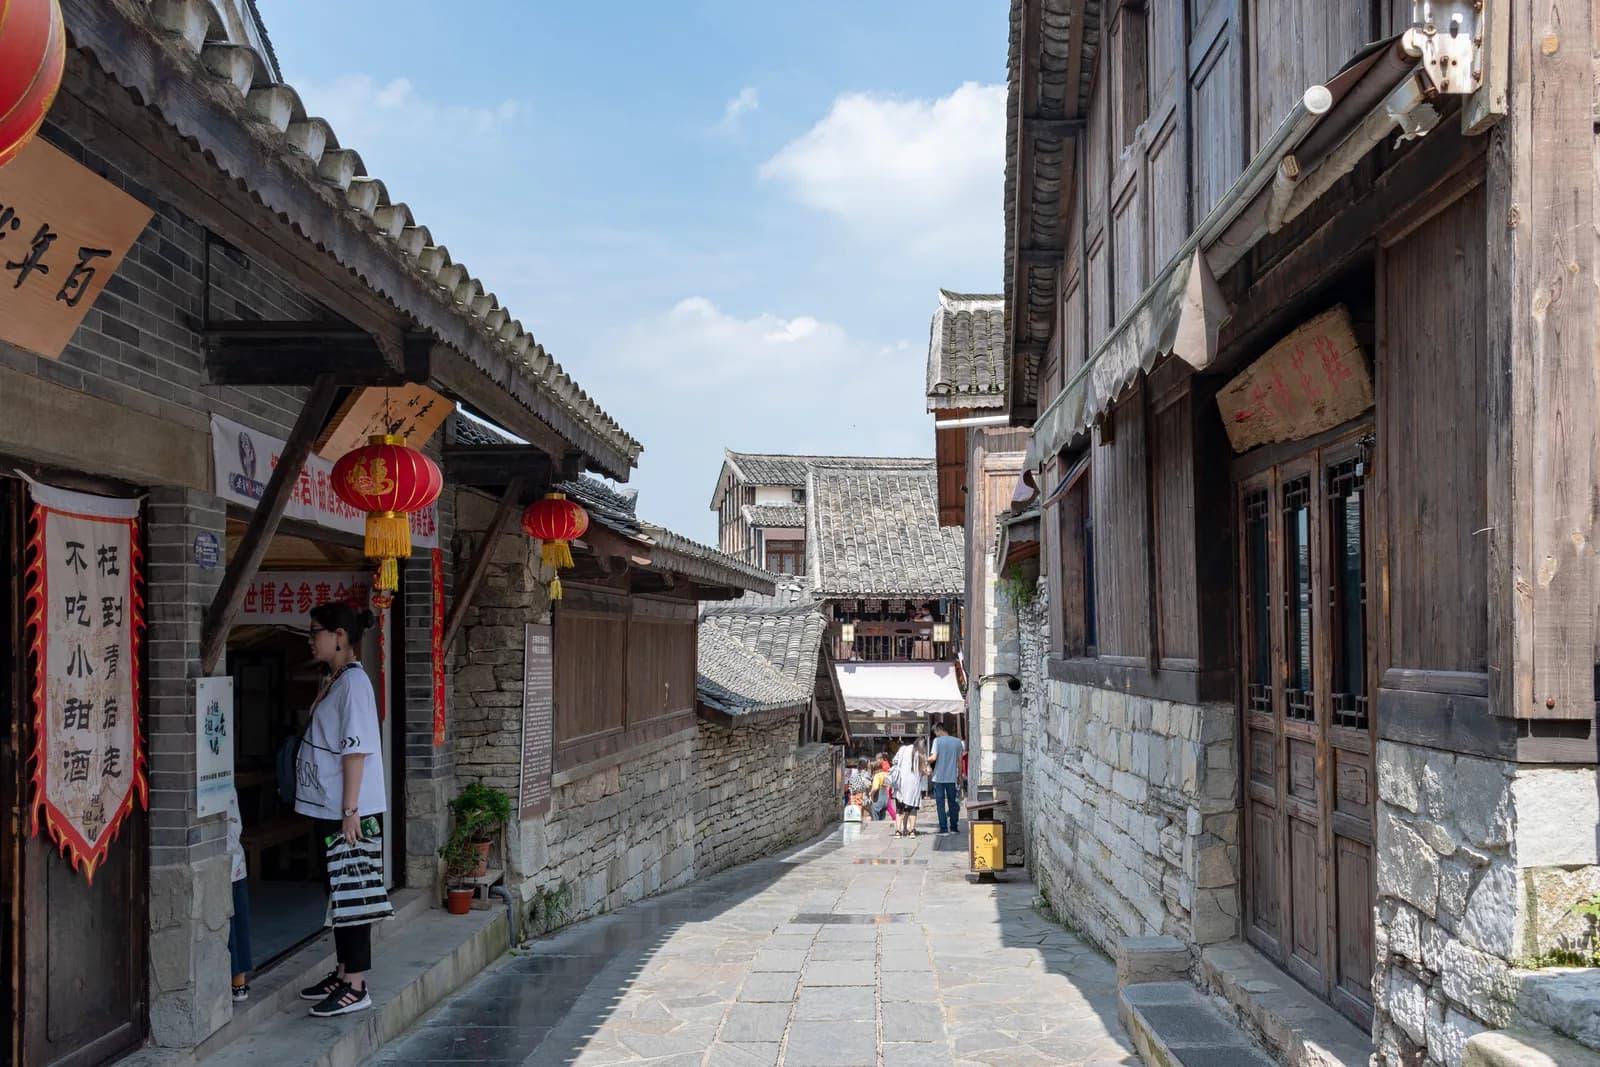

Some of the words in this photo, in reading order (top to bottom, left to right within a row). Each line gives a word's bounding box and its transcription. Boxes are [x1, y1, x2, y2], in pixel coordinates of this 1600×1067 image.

[63, 541, 94, 783] 不吃小甜酒
[97, 543, 123, 778] 枉到青岩走
